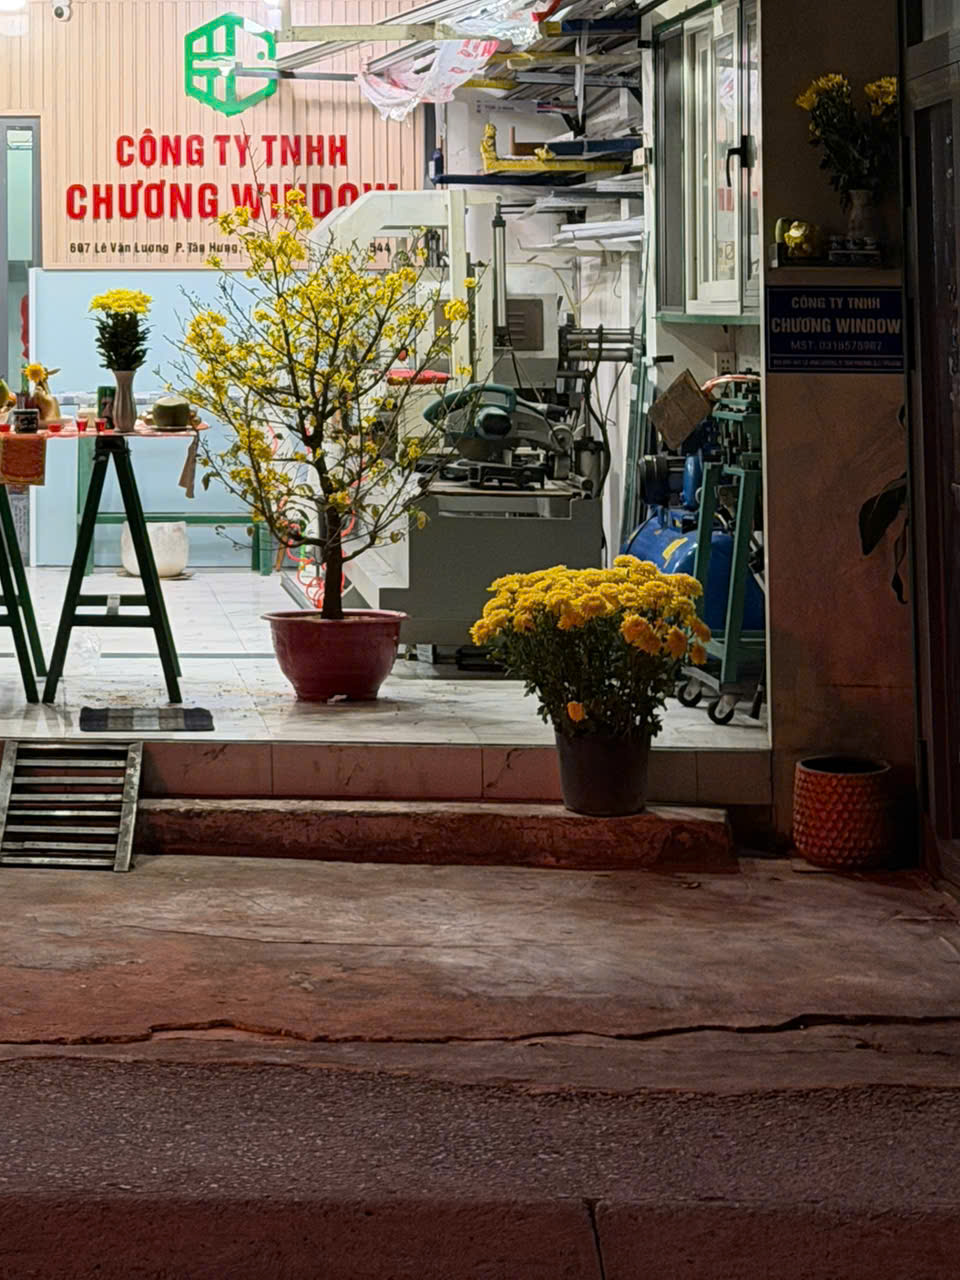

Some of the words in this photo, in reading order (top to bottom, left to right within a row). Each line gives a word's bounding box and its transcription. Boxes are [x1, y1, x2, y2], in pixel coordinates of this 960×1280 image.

[116, 128, 204, 167] CÔNG
[213, 134, 252, 167] TY
[261, 134, 348, 167] TNHH
[66, 179, 219, 220] CHƯƠNG
[792, 294, 825, 308] CÔNG
[829, 297, 843, 308] TY
[847, 297, 880, 309] TNHH
[771, 316, 831, 333] CHƯƠNG
[836, 318, 902, 334] WINDOW
